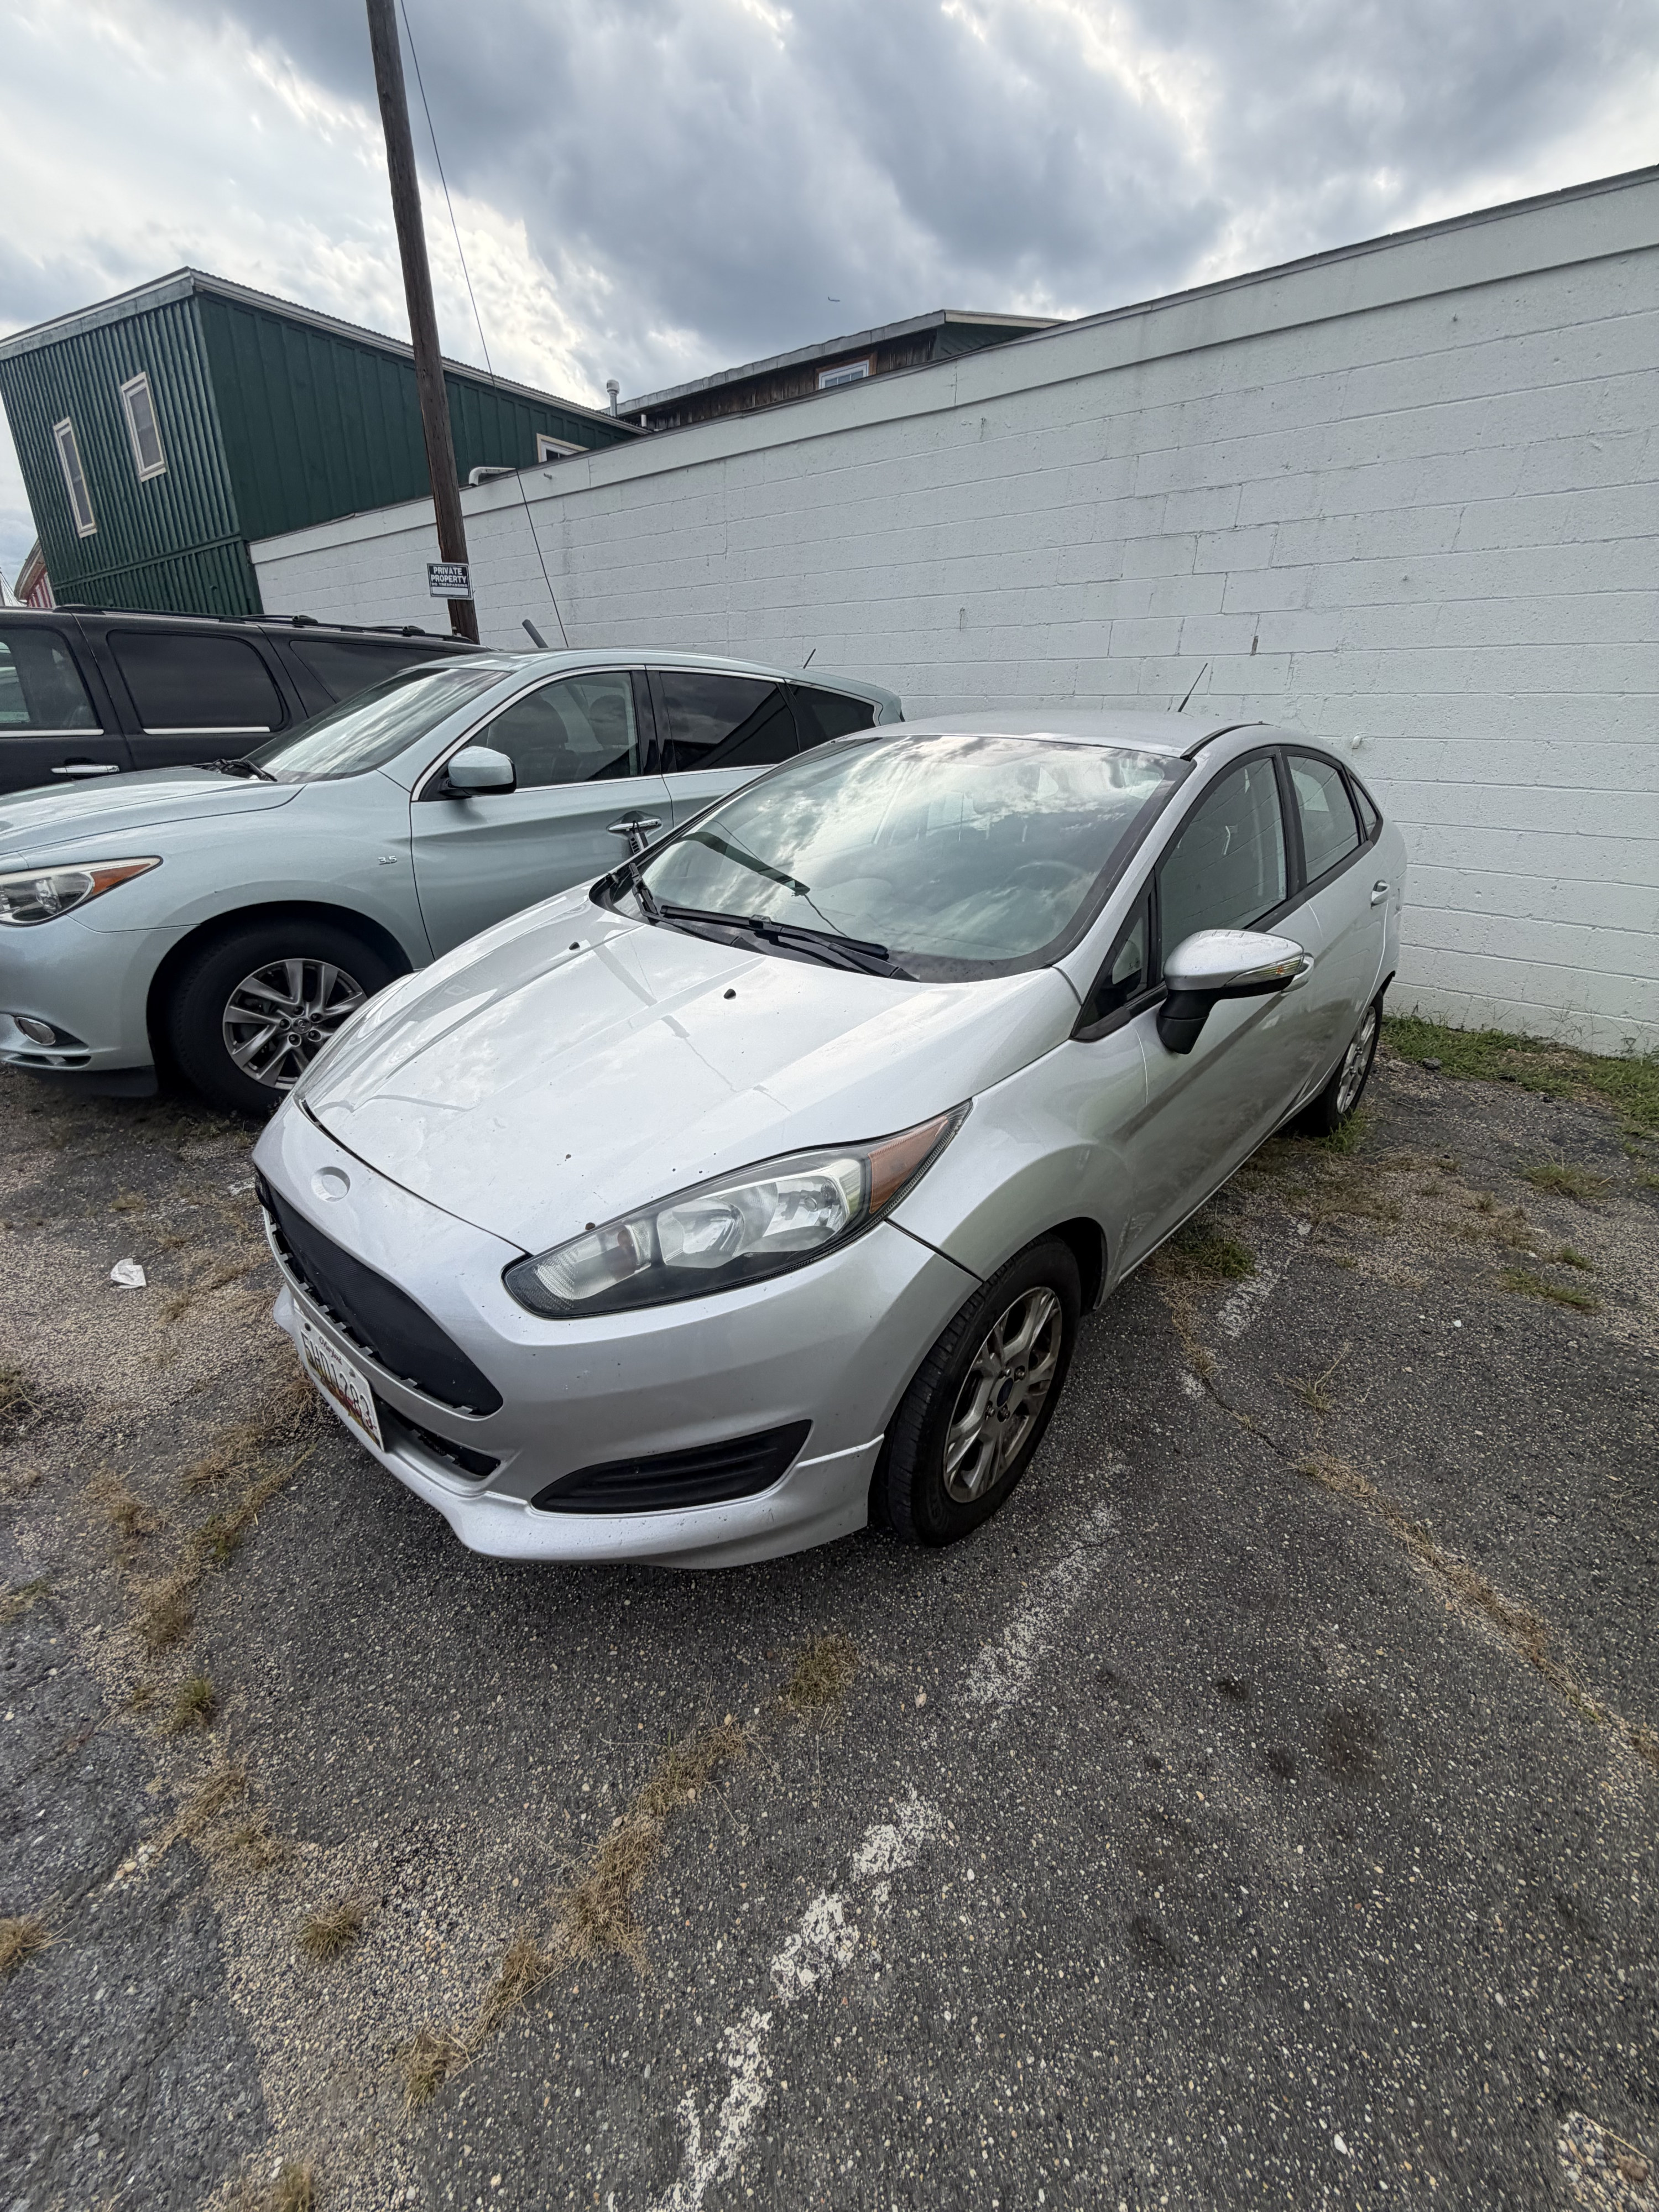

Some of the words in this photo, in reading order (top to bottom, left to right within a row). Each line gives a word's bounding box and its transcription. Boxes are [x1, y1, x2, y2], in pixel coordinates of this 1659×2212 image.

[433, 566, 463, 575] PRIVATE
[431, 575, 467, 583] PROPERTY
[377, 855, 398, 865] 3.5
[319, 1336, 342, 1365] Maryland
